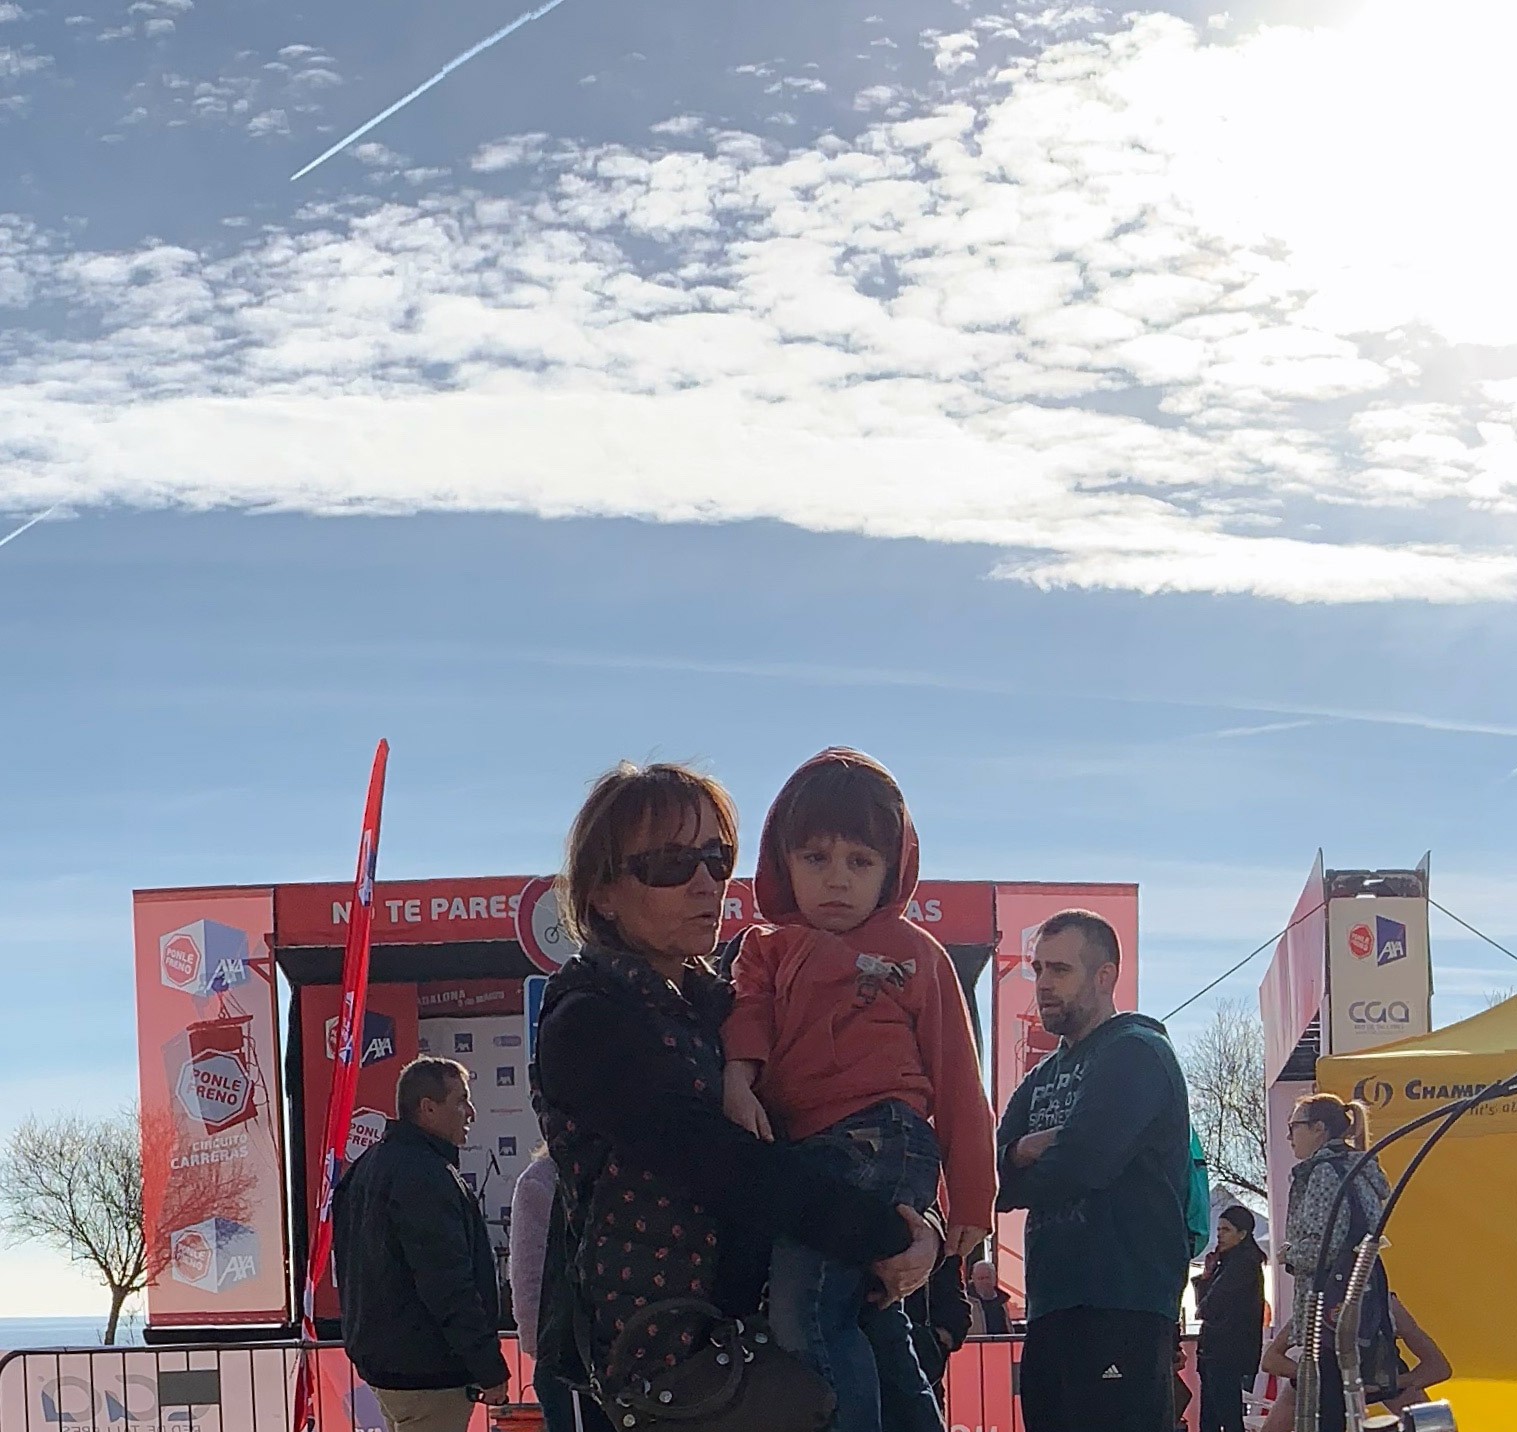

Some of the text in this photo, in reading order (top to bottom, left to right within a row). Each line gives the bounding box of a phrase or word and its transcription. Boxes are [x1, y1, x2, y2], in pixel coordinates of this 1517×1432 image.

[386, 898, 422, 923] TE
[431, 894, 520, 920] PARES
[166, 947, 194, 964] PONLE
[1378, 940, 1405, 963] AXA
[165, 957, 192, 976] FRENO
[360, 1037, 393, 1068] AXA
[193, 1067, 242, 1091] PONLE
[187, 1084, 238, 1106] FRENO
[350, 1122, 386, 1139] PONL
[192, 1133, 248, 1152] CIRCUITO
[170, 1146, 249, 1170] CARRERAS
[217, 1255, 257, 1287] AXA
